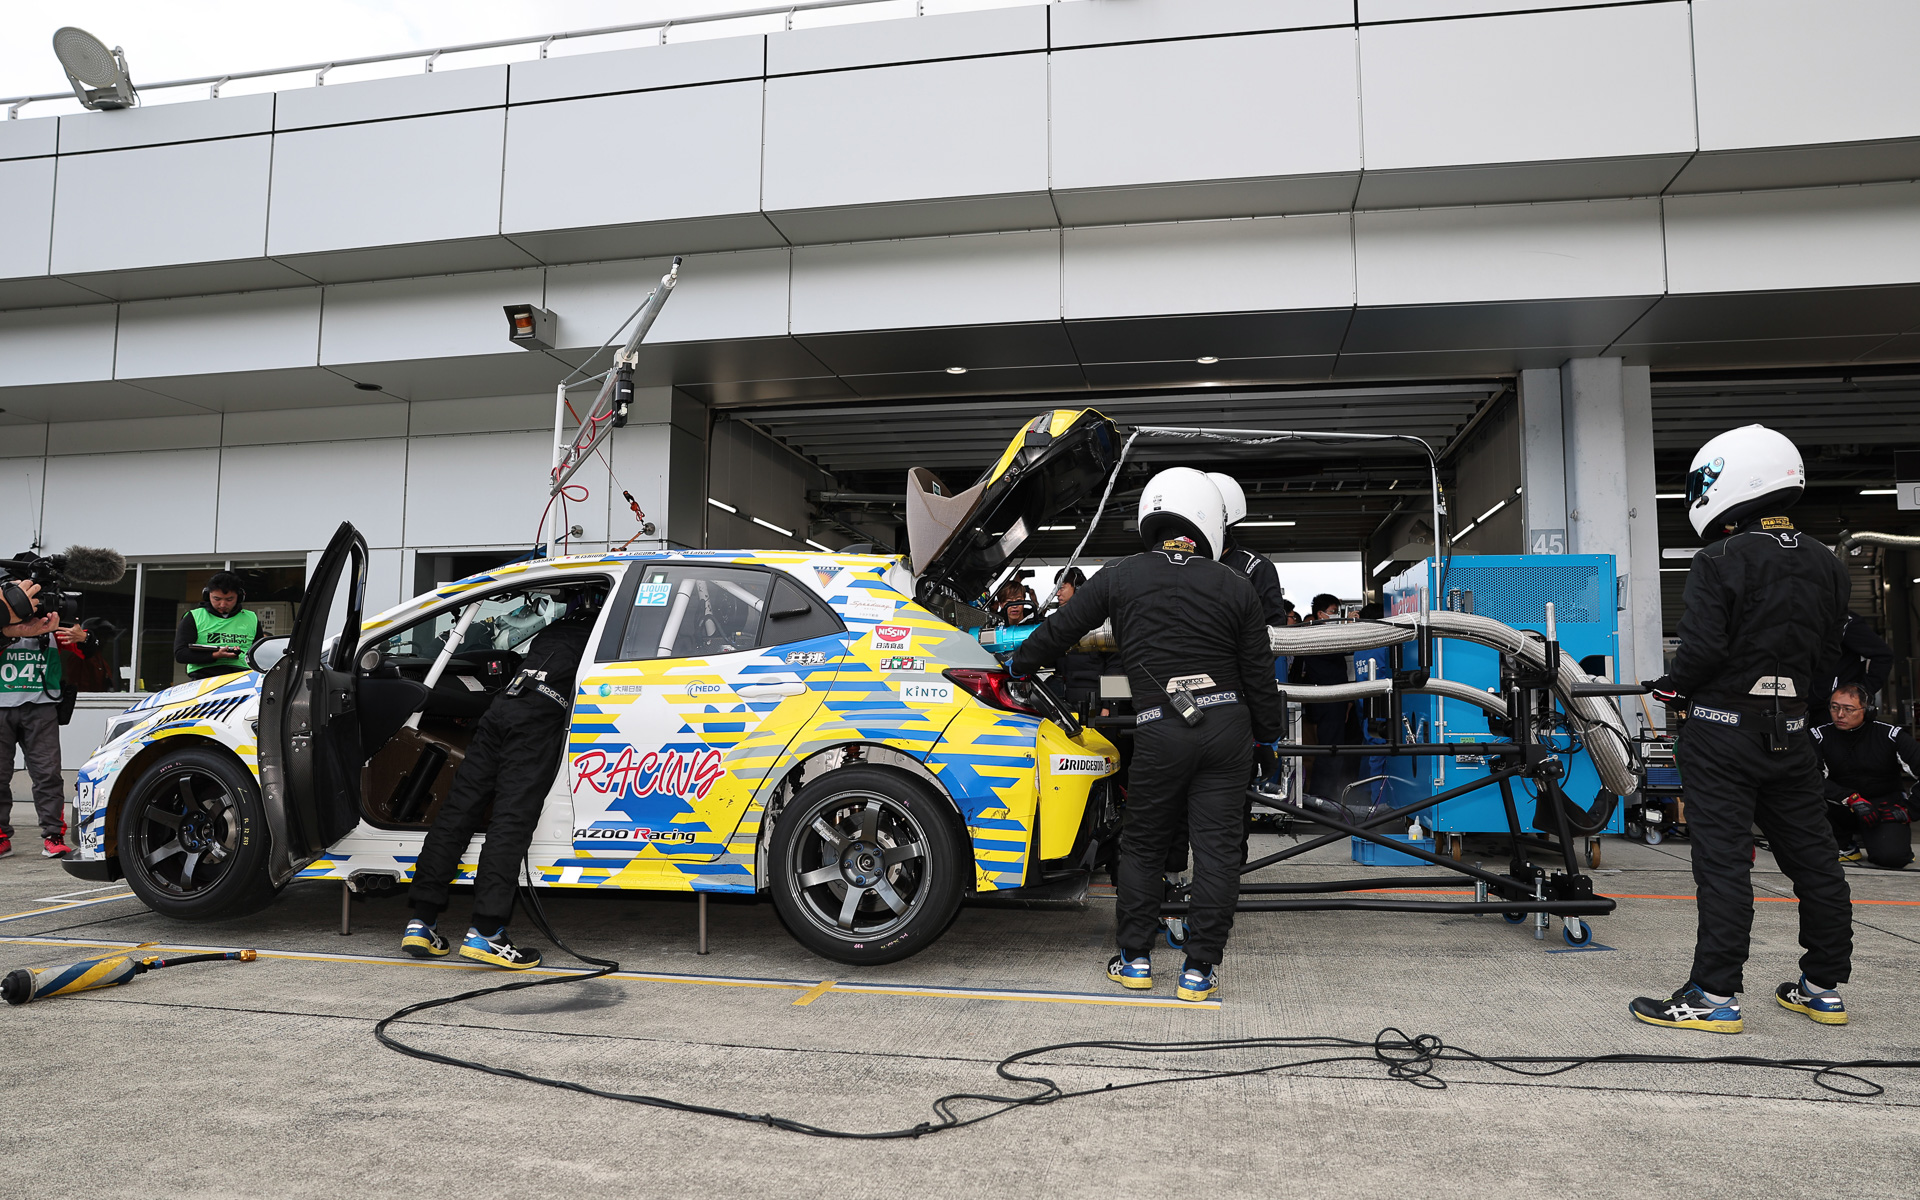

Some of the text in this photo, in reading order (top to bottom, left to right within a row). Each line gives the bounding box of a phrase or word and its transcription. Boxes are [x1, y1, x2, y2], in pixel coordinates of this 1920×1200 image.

[1533, 534, 1563, 555] 45
[640, 584, 669, 592] LIQUID
[637, 592, 667, 604] H2
[850, 601, 892, 611] Speedway
[878, 627, 906, 637] NISSIN
[6, 652, 45, 661] MEDIA
[881, 658, 924, 670] ジャンボ
[0, 663, 47, 682] 047
[695, 685, 720, 693] NEDO
[537, 684, 569, 709] sparco
[1196, 692, 1237, 707] sparco
[1693, 706, 1738, 724] sparco
[573, 747, 726, 800] RACING
[574, 828, 696, 844] AZOO Racing
